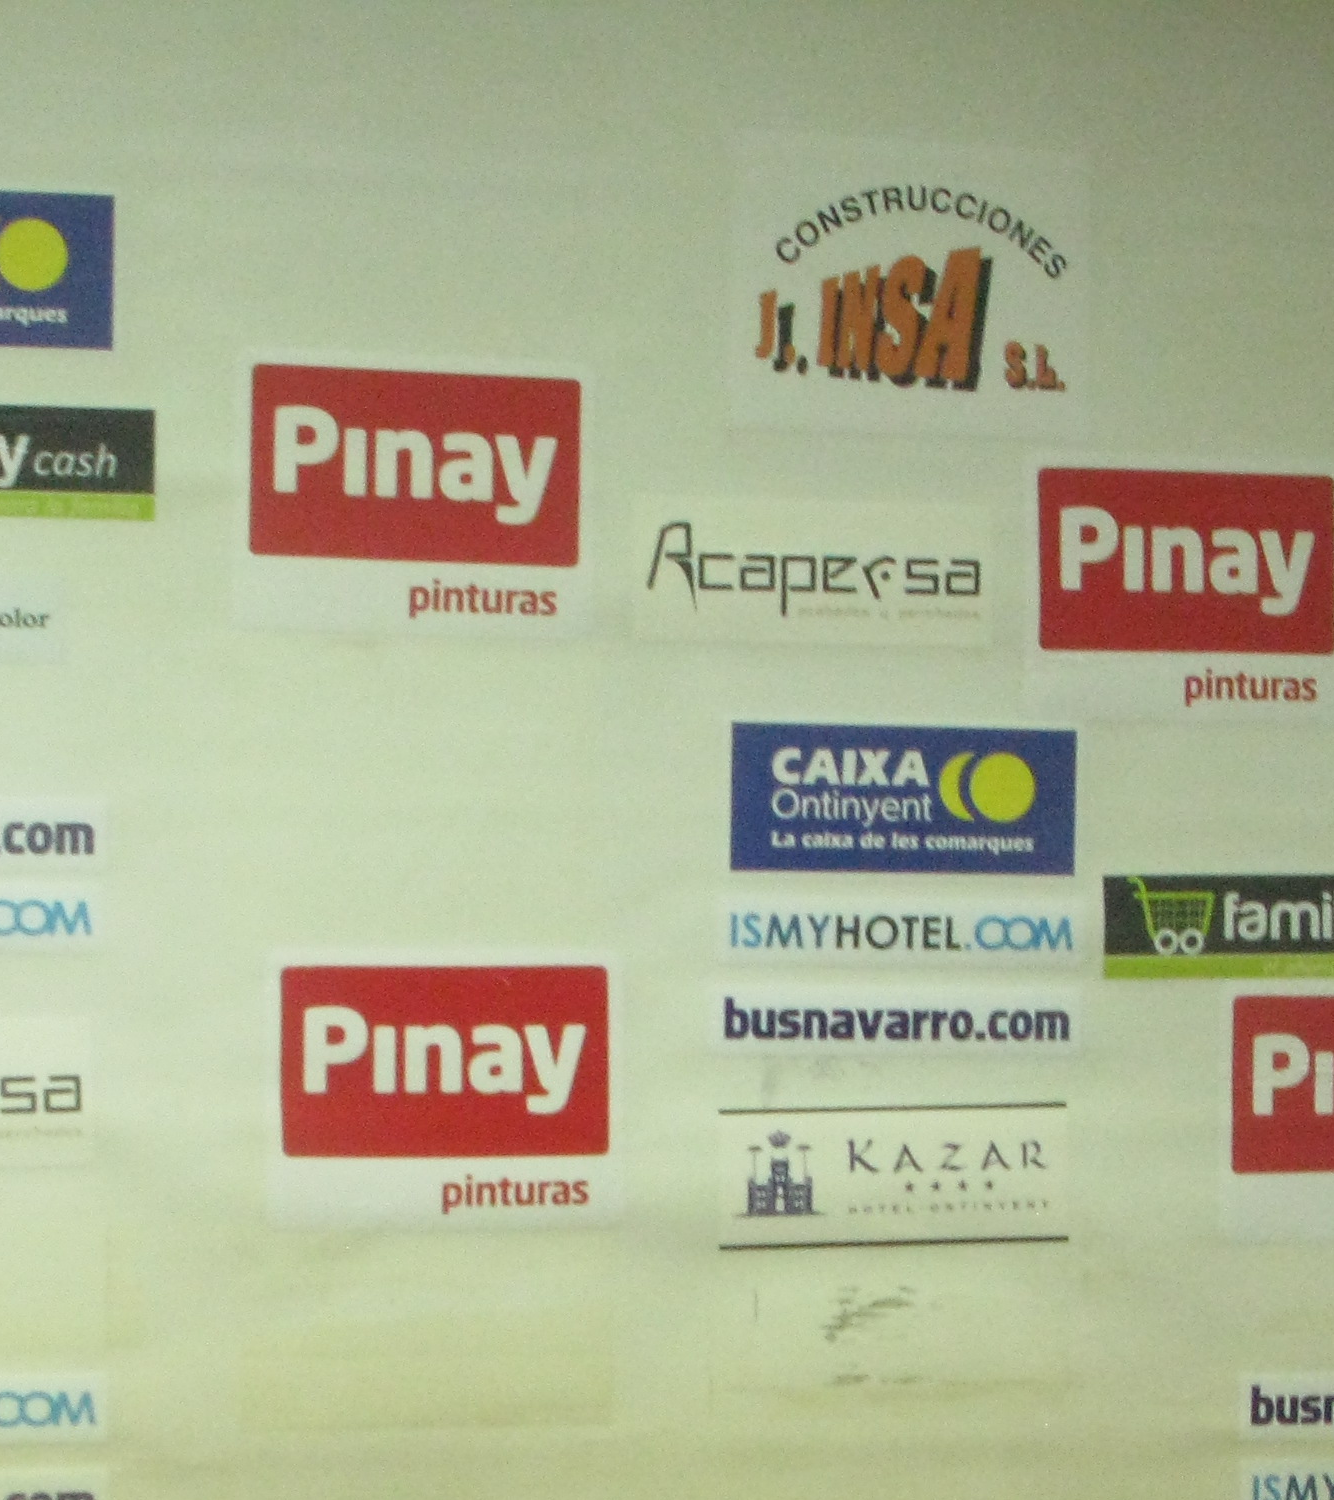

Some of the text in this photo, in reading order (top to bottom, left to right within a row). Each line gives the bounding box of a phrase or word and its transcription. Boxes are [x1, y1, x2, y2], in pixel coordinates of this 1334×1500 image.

[775, 185, 1067, 280] CONSTRUCCIONES
[816, 246, 993, 392] INSA
[1004, 339, 1066, 392] S.L.
[33, 444, 118, 479] cash
[273, 405, 558, 526] Pinay
[1059, 505, 1315, 617] Pinay
[408, 579, 559, 620] pinturas
[1184, 667, 1318, 706] pinturas
[772, 747, 931, 788] CAIXA
[771, 788, 933, 829] Ontinyent
[771, 830, 1035, 855] La caixa de les comarques
[730, 912, 1074, 953] ISMYHOTEL.COM
[723, 997, 1070, 1042] busnavarro.com
[303, 1005, 588, 1116] Pinay
[847, 1137, 1048, 1175] KAZAR
[441, 1174, 591, 1215] pinturas
